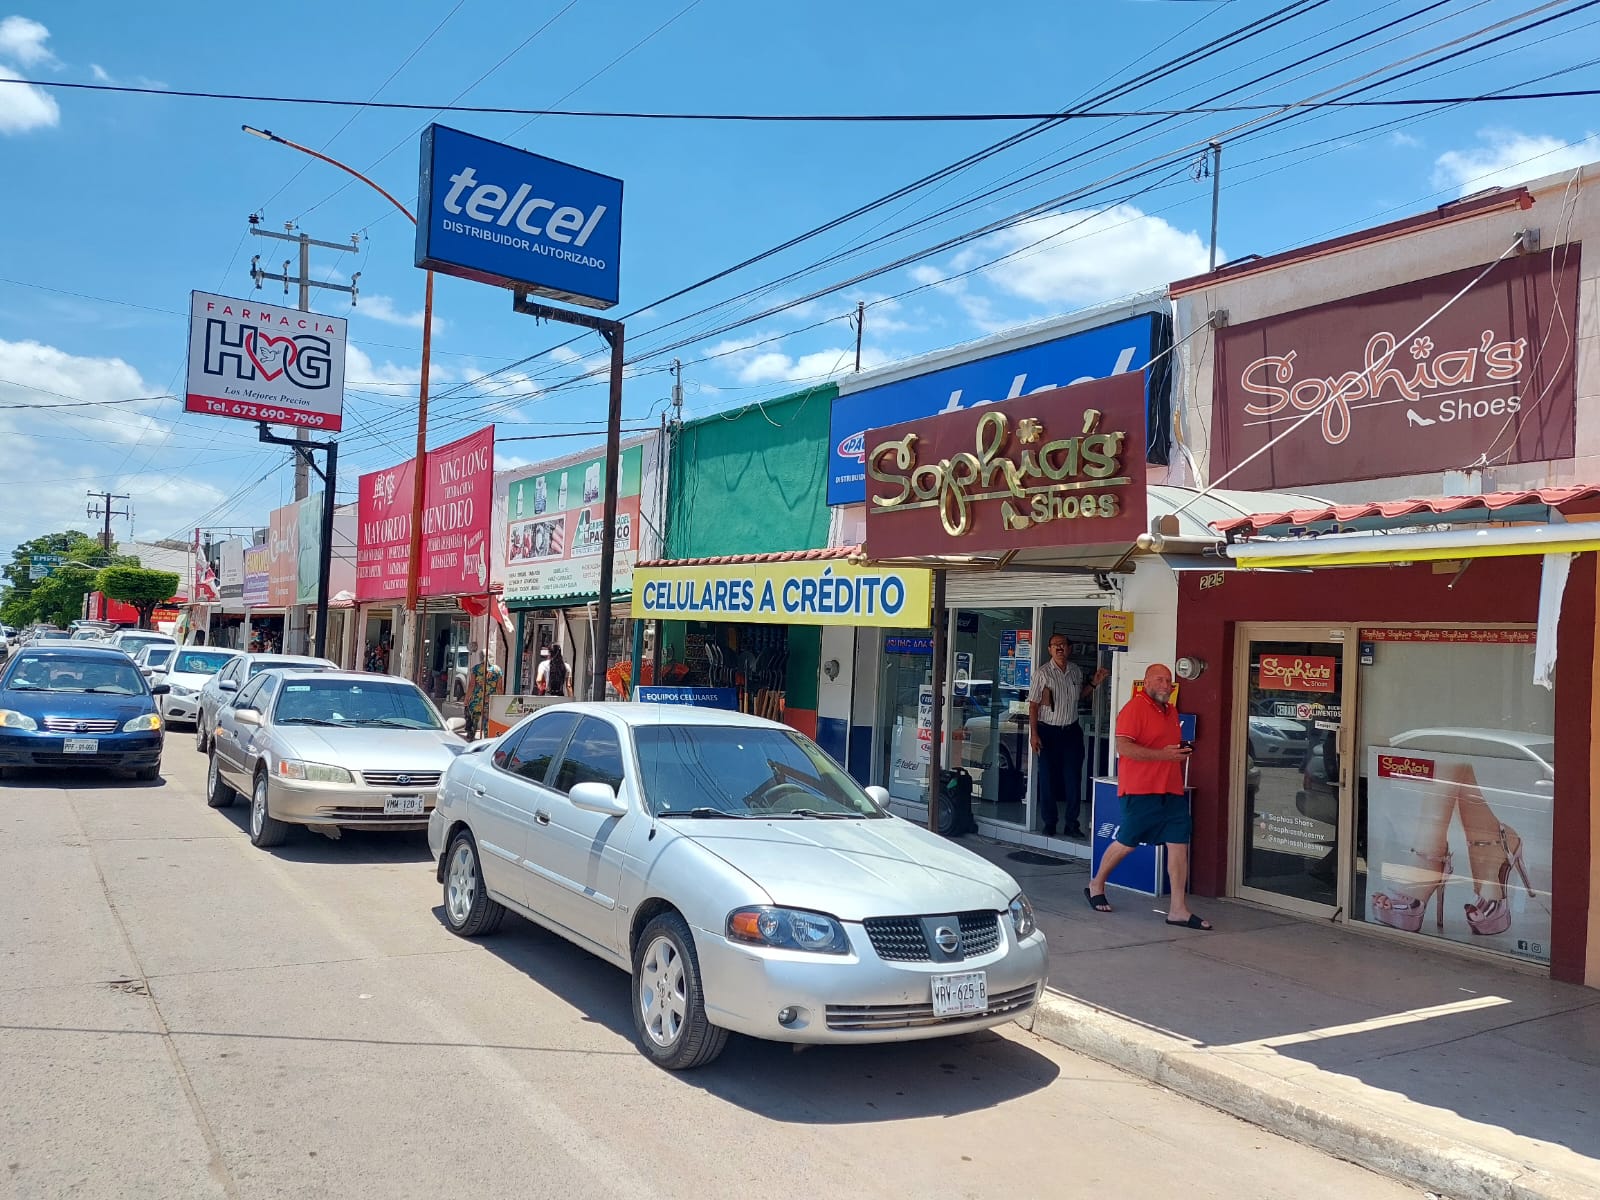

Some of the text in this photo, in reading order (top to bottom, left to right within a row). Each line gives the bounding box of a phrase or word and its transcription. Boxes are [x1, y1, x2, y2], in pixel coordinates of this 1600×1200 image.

[443, 167, 607, 247] telcel
[443, 219, 606, 270] DISTRIBUIDOR AUTORIZADO
[207, 302, 335, 334] FARMACIA
[224, 386, 311, 406] Los Mejores Precios
[1241, 329, 1527, 444] Sophia's
[206, 400, 229, 413] Tel.
[232, 404, 257, 416] 673
[1438, 395, 1521, 423] Shoes
[440, 446, 488, 485] XING LONG
[868, 408, 1126, 537] Sophia's
[364, 516, 406, 545] MAYOREO
[421, 498, 473, 535] MENUDEO
[1031, 493, 1119, 523] Shoes
[643, 566, 905, 614] CELULARES A CRÉDITO
[1201, 572, 1223, 588] 225
[1262, 658, 1330, 687] Sophia's
[646, 693, 718, 702] EQUIPOS CELULARES
